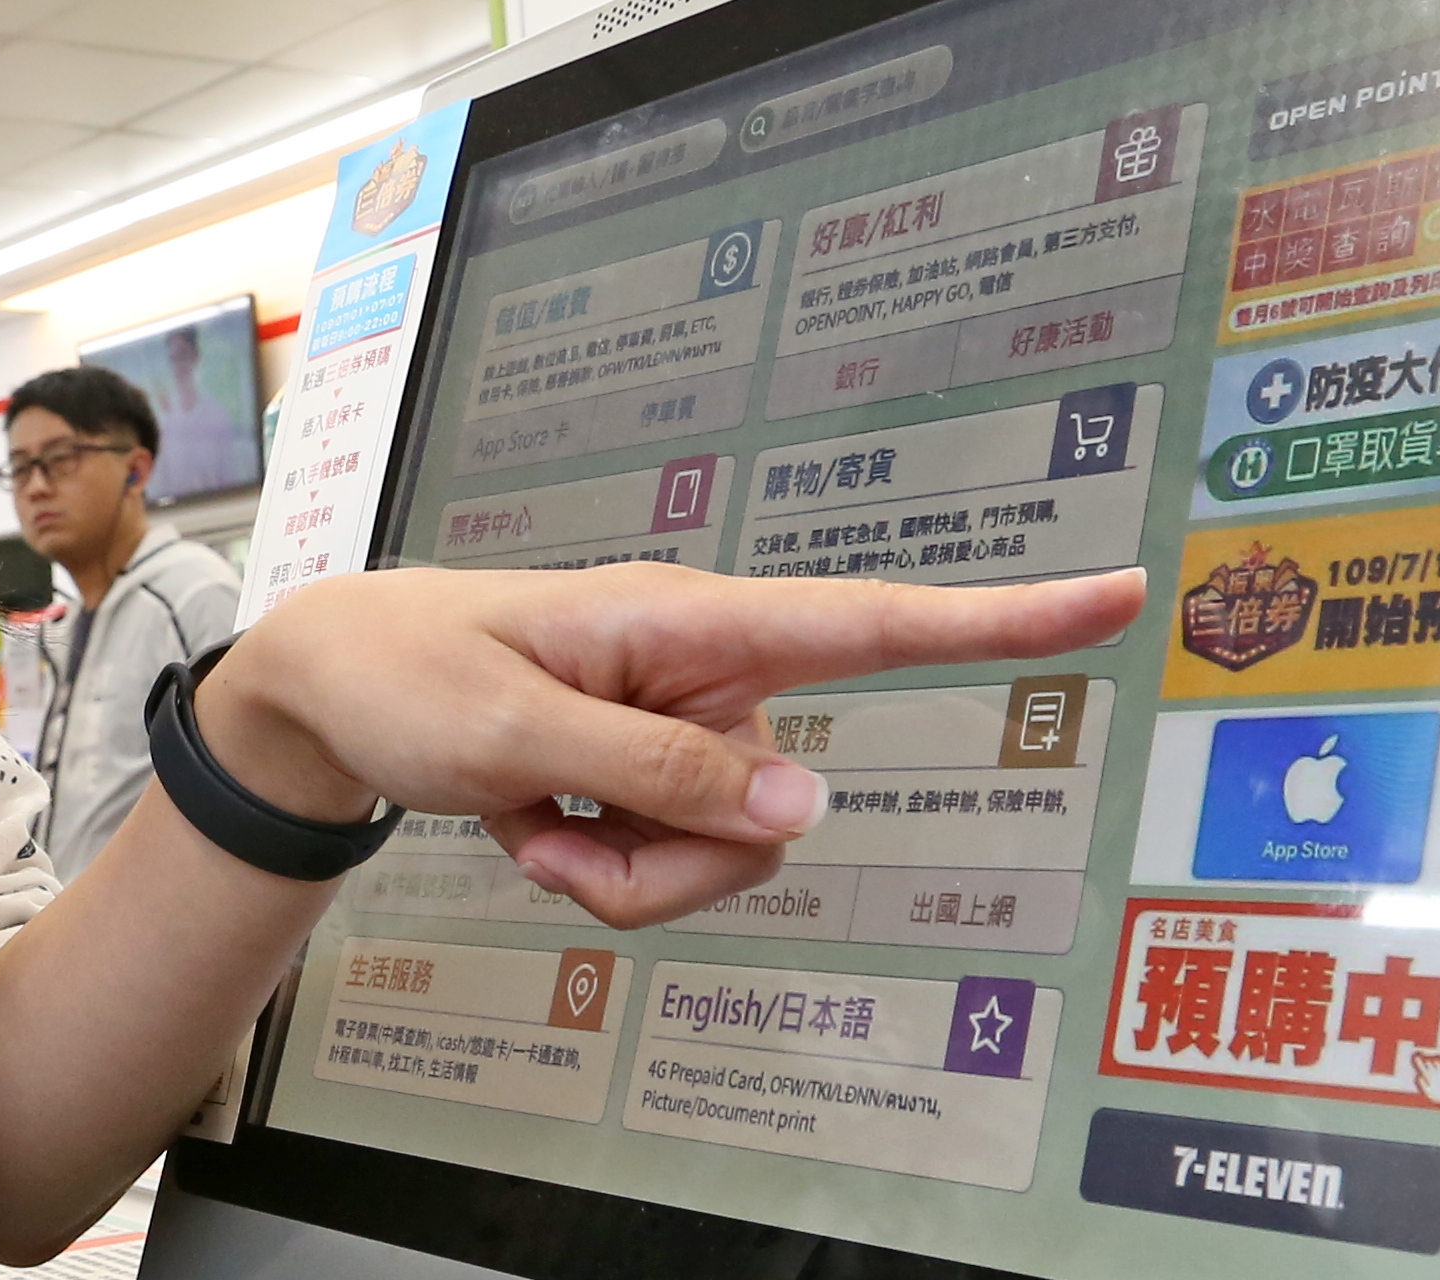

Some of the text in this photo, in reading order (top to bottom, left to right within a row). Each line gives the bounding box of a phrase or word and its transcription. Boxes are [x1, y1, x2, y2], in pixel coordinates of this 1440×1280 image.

[1268, 94, 1347, 131] OPEN
[809, 190, 945, 258] 好康/紅利
[1243, 214, 1411, 281] 中獎查詢
[907, 256, 962, 286] 加油站,
[795, 300, 888, 336] OPENPOINT,
[891, 286, 943, 322] HAPPY
[945, 280, 976, 305] GO,
[1009, 310, 1116, 359] 好康活動
[834, 357, 881, 392] 銀行
[640, 395, 697, 428] 停車費
[472, 421, 570, 462] App Store 卡
[762, 447, 894, 503] 購物/寄貨
[445, 504, 534, 548] 票券中心
[751, 497, 1059, 558] 交貨便, 黑貓宅急便, 國際快遞, 門市預購,
[918, 532, 1027, 567] 認捐愛心商品
[1192, 593, 1302, 637] 三倍券
[772, 713, 834, 754] 服務
[906, 791, 982, 815] 金融申辦,
[987, 790, 1069, 815] 保險申辦,
[1261, 839, 1348, 862] App Store
[746, 886, 822, 921] mobile
[909, 891, 1017, 928] 出國上網
[1150, 916, 1238, 943] 名店美食
[346, 954, 435, 996] 生活服務
[660, 982, 877, 1042] English/日本語
[648, 1060, 667, 1080] 4G
[669, 1062, 726, 1088] Prepaid
[728, 1069, 766, 1097] Card,
[641, 1089, 817, 1135] Picture/Document print
